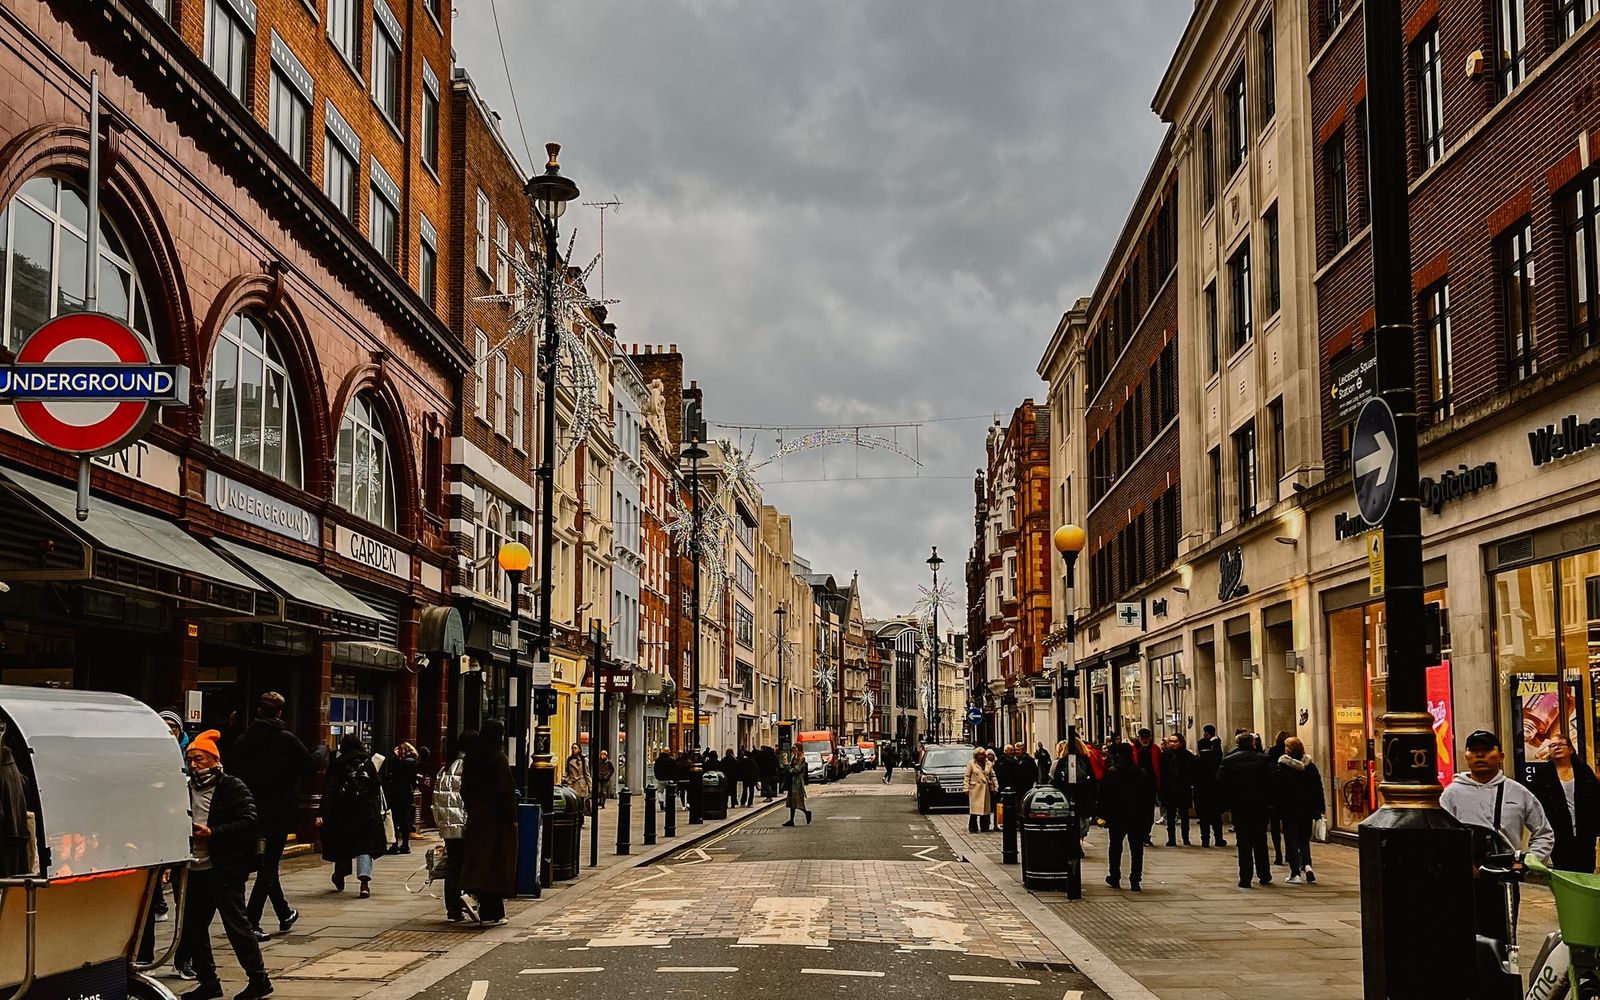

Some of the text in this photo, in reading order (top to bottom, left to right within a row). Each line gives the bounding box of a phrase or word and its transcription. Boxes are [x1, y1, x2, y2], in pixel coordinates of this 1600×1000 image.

[0, 370, 173, 394] UNDERGROUND
[1338, 356, 1377, 387] Leicester Square
[1338, 383, 1356, 400] Station
[1419, 461, 1498, 515] Opticians
[215, 474, 312, 542] UNDERGROUND
[350, 532, 398, 574] GARDEN
[612, 675, 630, 683] MUJI
[1522, 682, 1551, 693] NEW
